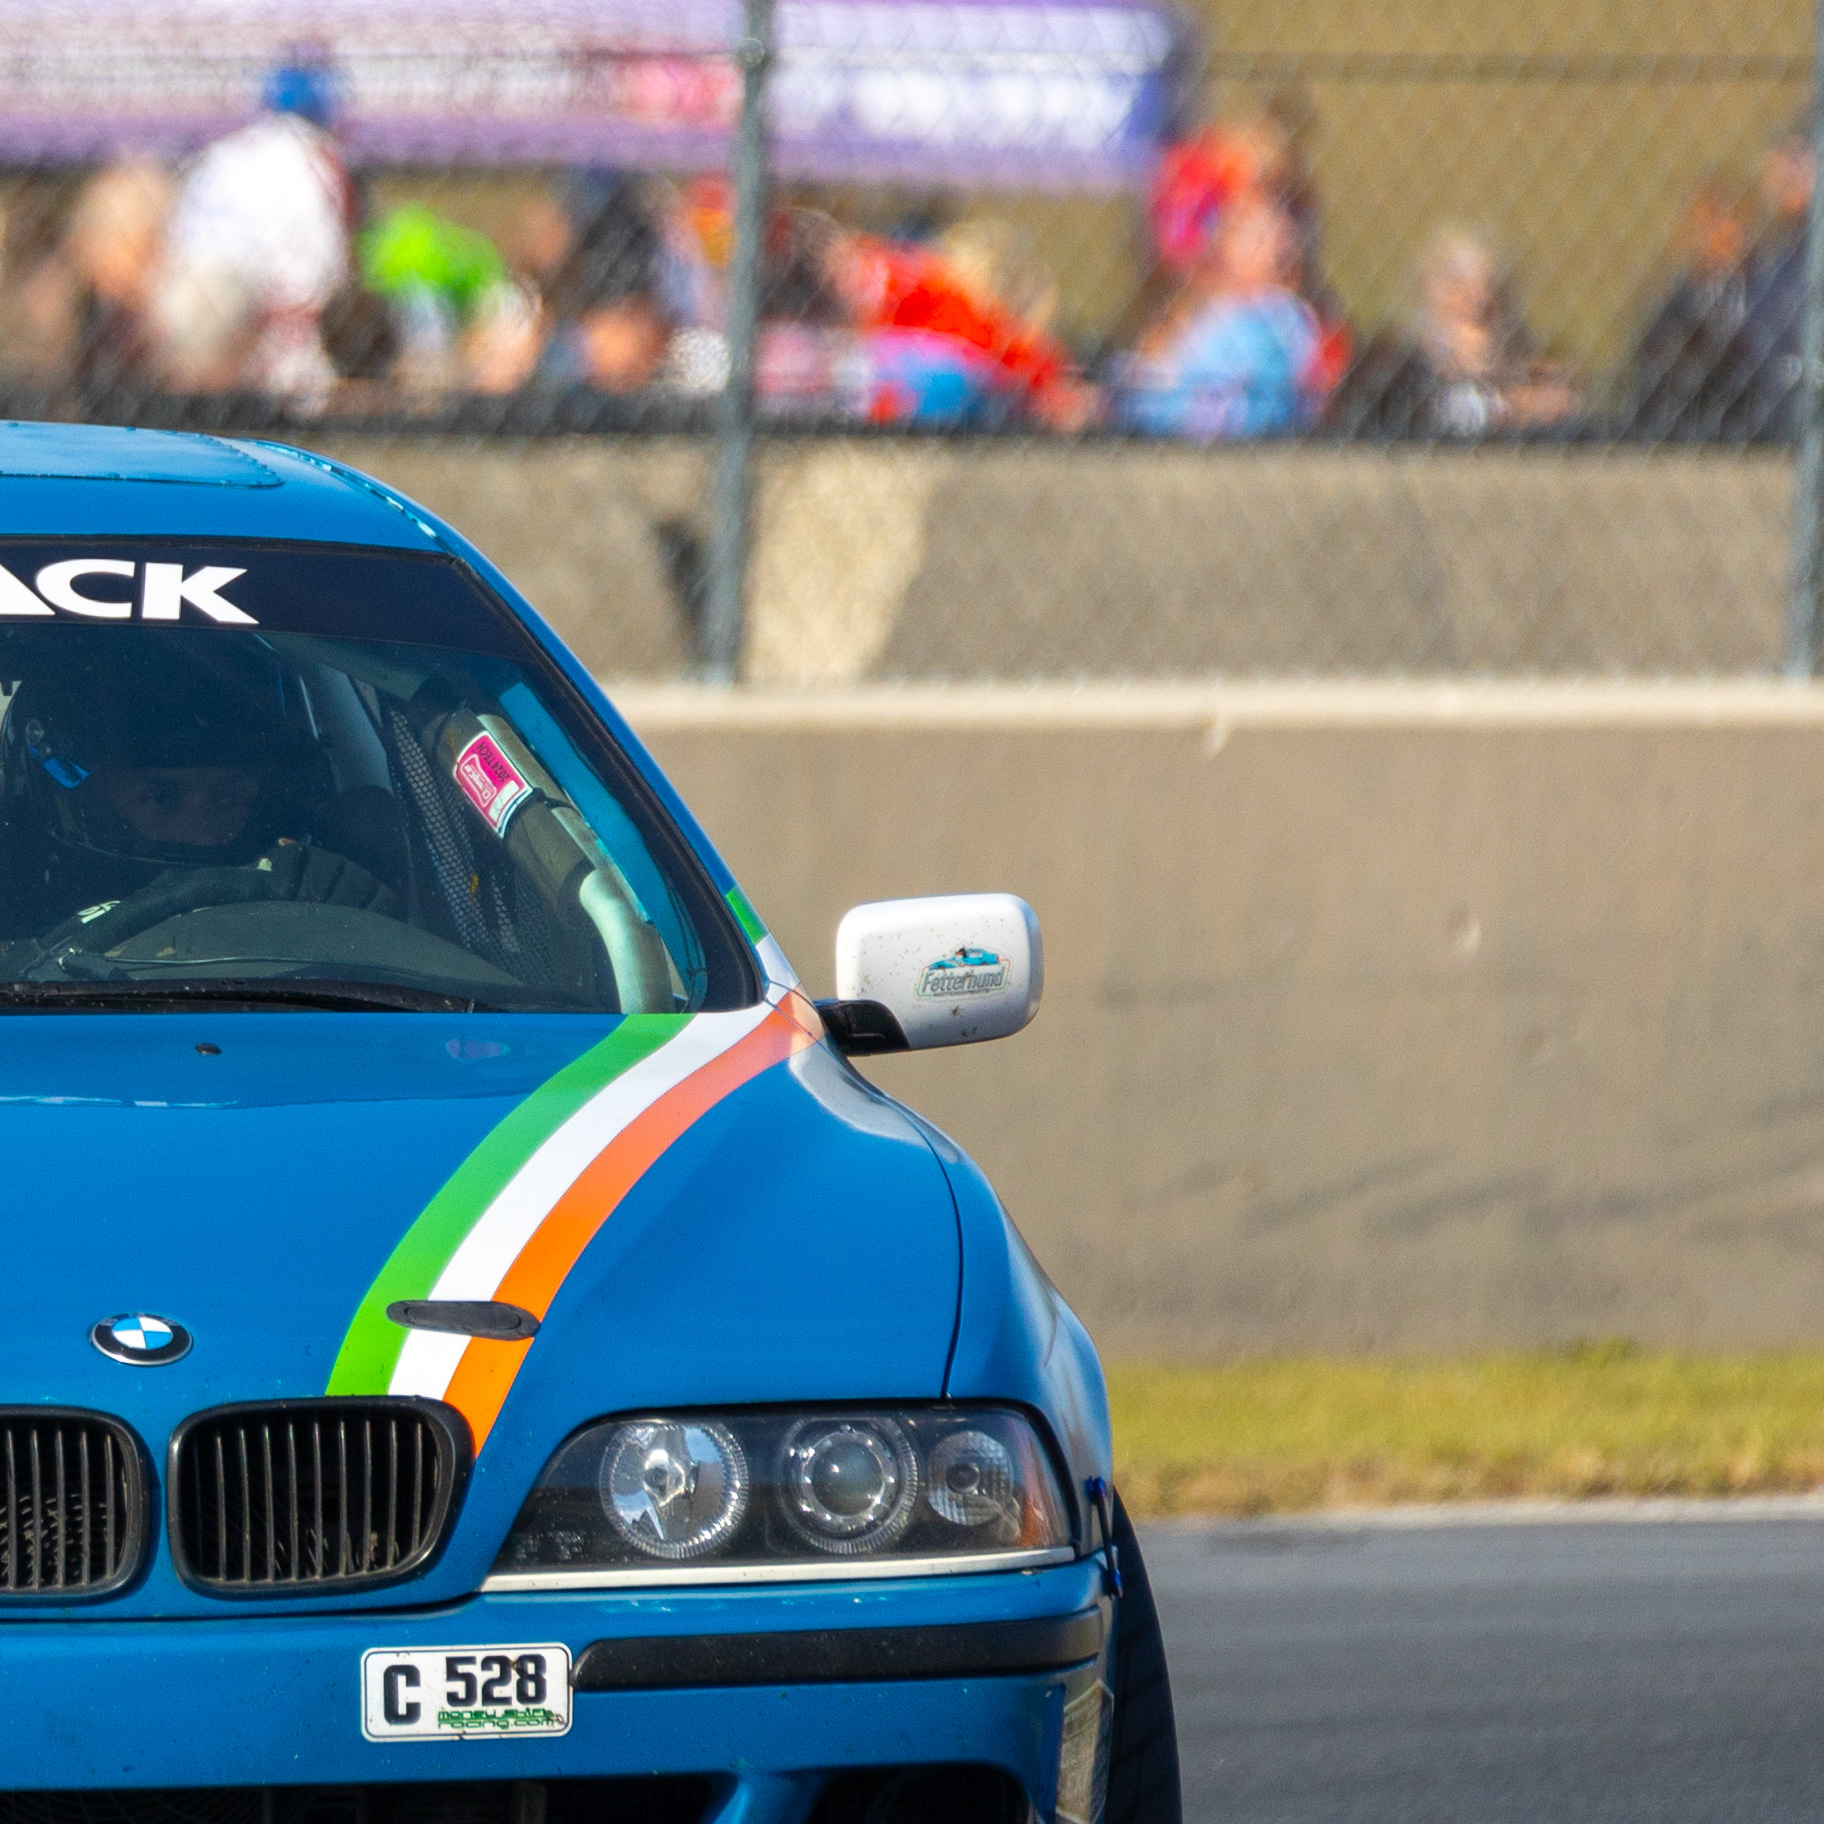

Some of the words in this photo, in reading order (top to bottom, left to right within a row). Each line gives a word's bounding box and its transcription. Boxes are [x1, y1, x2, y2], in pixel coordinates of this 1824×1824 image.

[921, 966, 1005, 994] Fetterhund
[383, 1664, 421, 1726] C
[445, 1654, 547, 1708] 528
